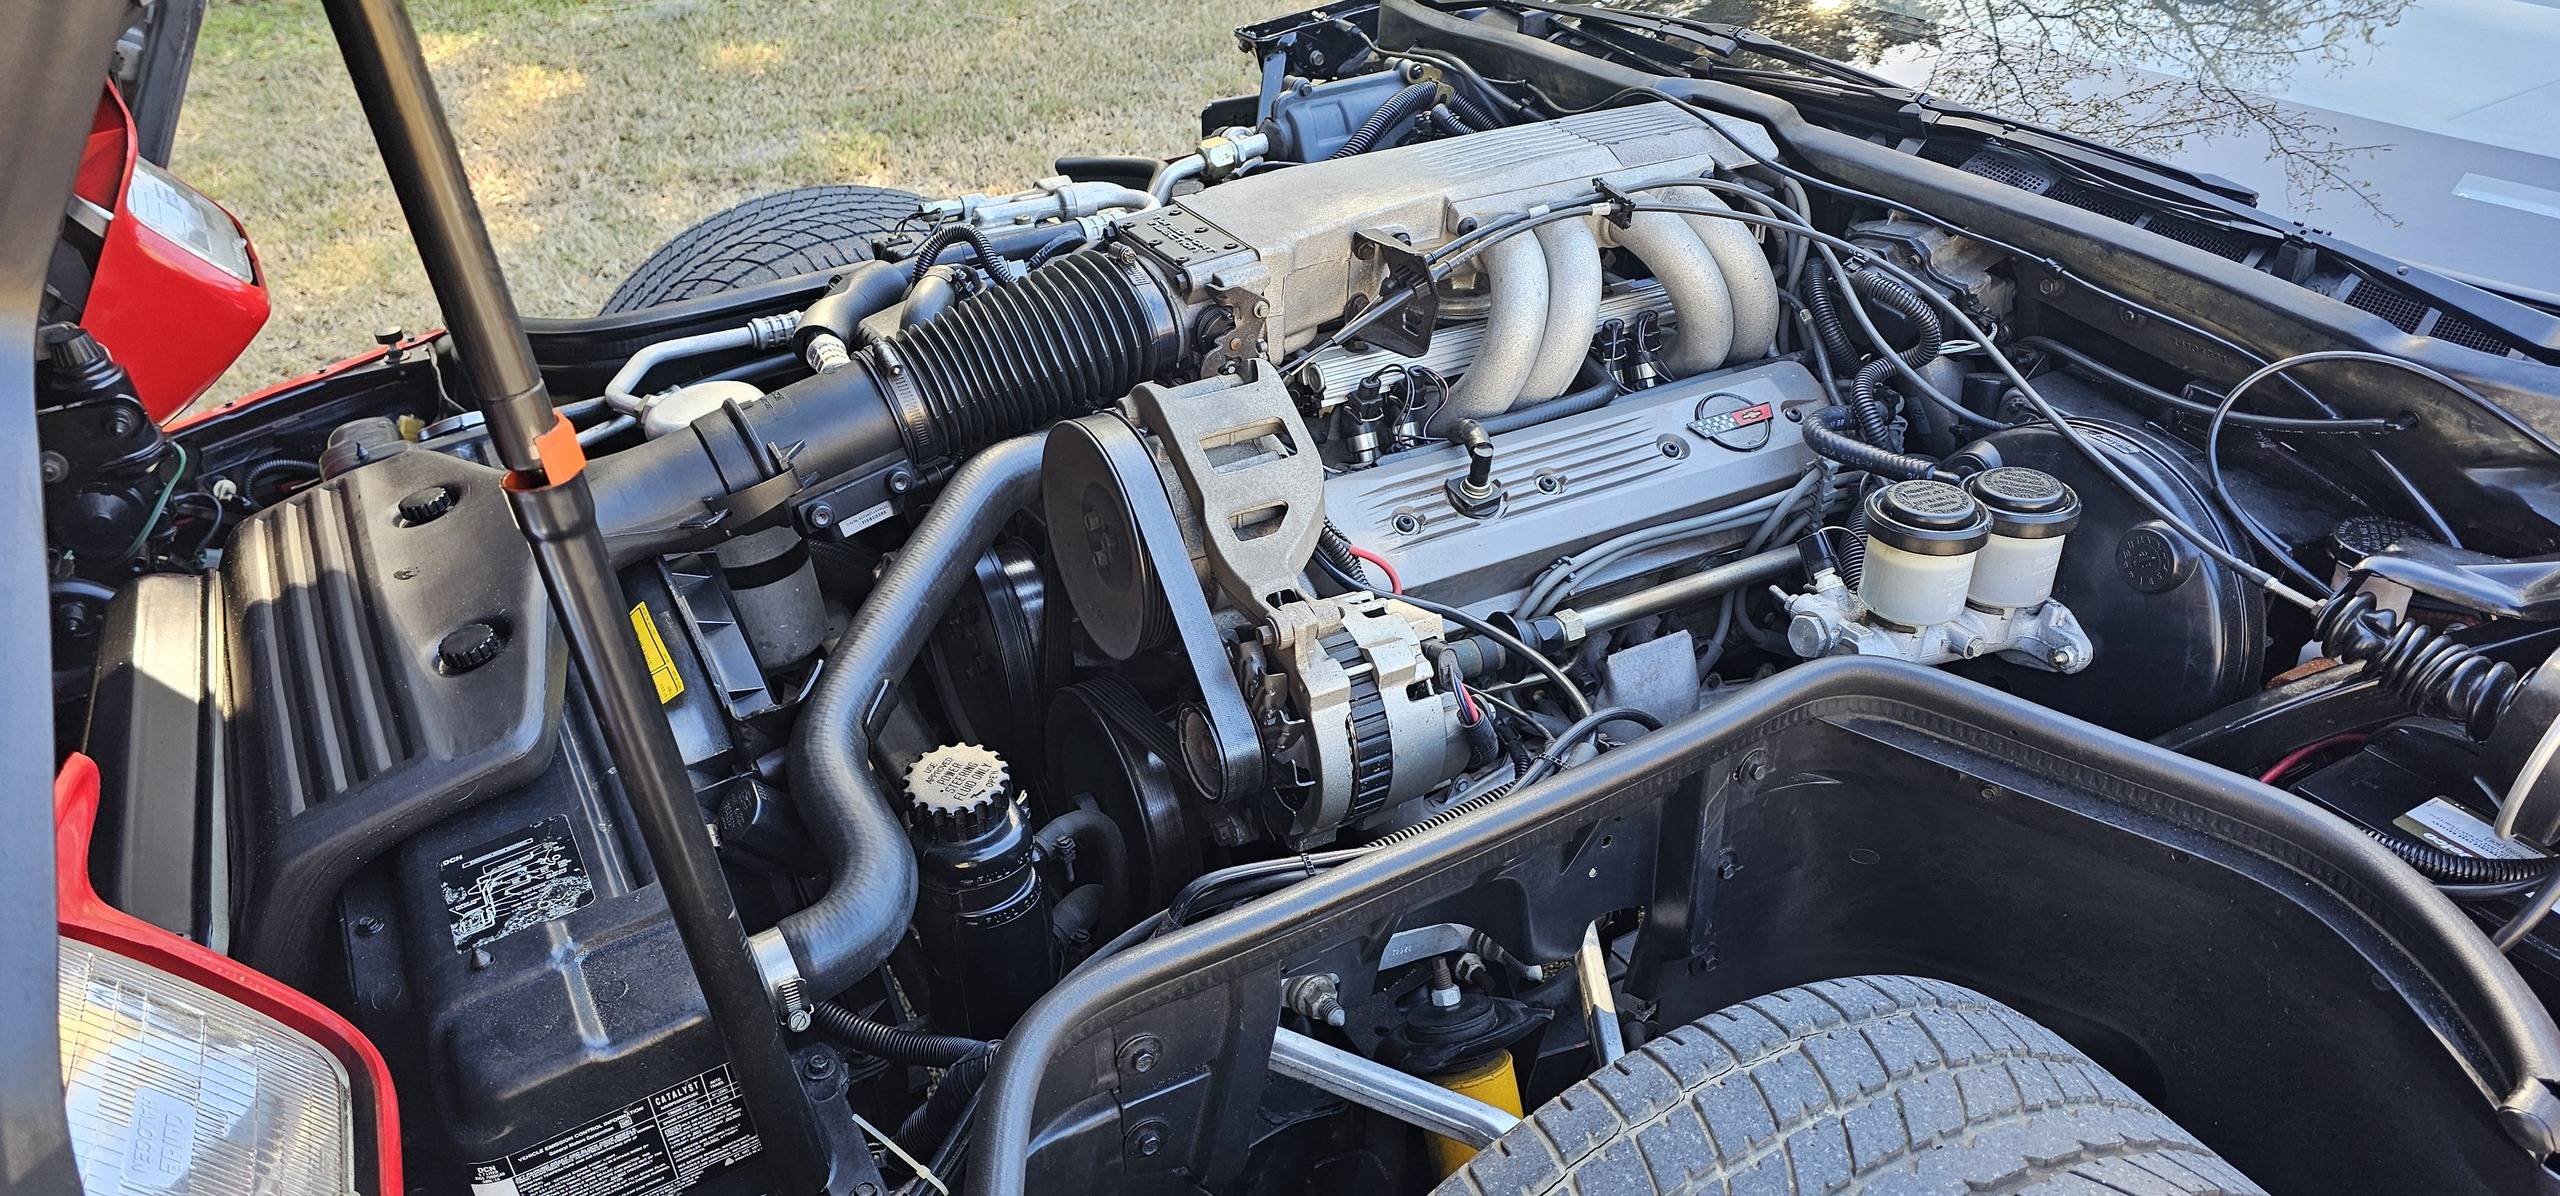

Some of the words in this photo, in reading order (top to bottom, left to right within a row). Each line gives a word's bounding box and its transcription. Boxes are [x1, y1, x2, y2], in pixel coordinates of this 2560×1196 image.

[1148, 222, 1200, 252] INJECTION
[1153, 214, 1186, 235] TUNED
[1185, 233, 1217, 253] PORT
[923, 763, 938, 774] USE
[925, 757, 953, 784] APPROVED
[937, 763, 962, 786] POWER
[945, 761, 978, 794] STEERING
[953, 780, 977, 801] FLUID
[973, 763, 992, 784] ONLY
[654, 1080, 699, 1106] CATALYST
[517, 1147, 544, 1163] VEHICLE
[543, 1135, 574, 1151] EMISSION
[573, 1122, 603, 1139] CONTROL
[602, 1105, 644, 1126] INFORMATION
[477, 1162, 499, 1175] DCN
